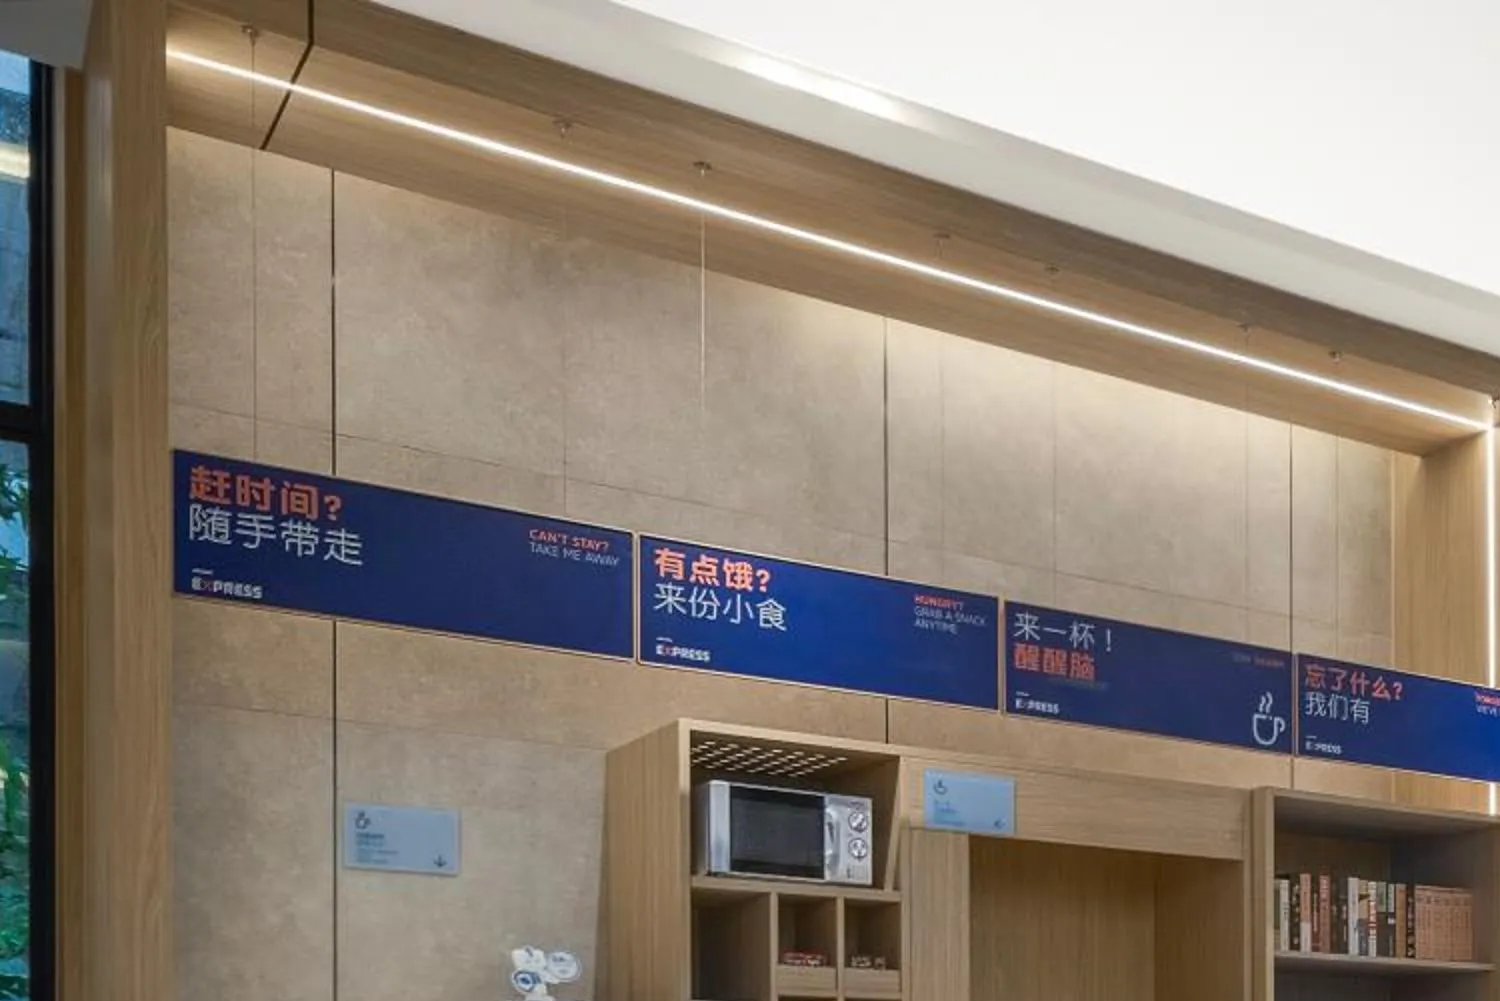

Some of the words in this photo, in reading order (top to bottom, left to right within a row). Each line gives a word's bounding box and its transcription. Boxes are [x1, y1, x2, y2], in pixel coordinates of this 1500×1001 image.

[189, 465, 343, 520] 赶时间?
[189, 503, 363, 566] 随手带走
[529, 529, 567, 545] CAN'T
[529, 541, 558, 557] TAKE
[563, 547, 580, 560] ME
[585, 552, 620, 566] AWAY
[654, 547, 771, 592] 有点饿?
[653, 582, 787, 631] 来份小食
[1304, 691, 1370, 725] 我们有
